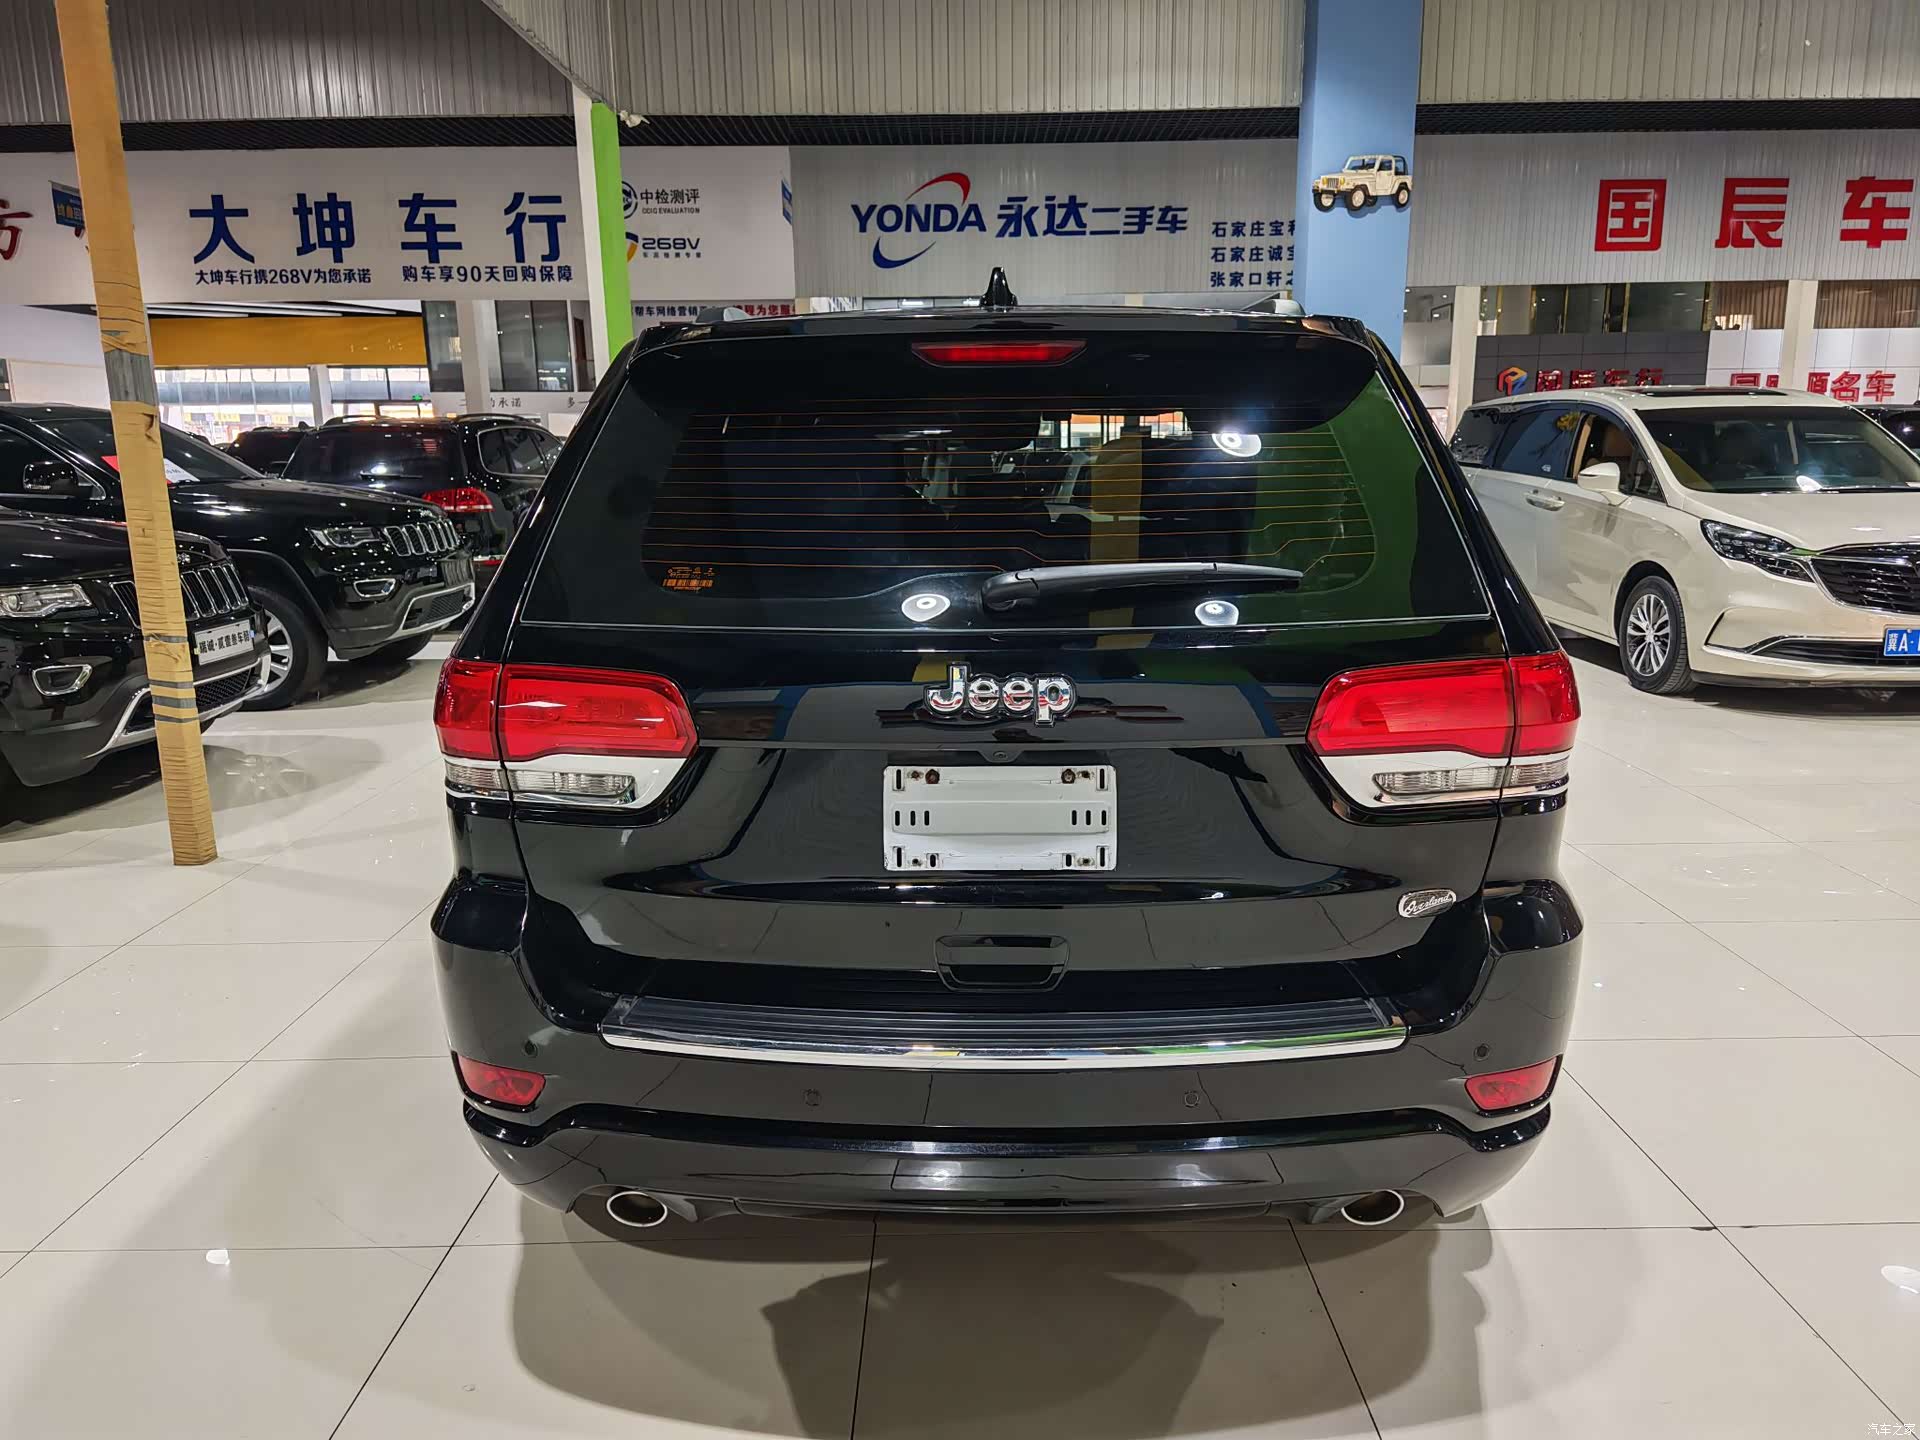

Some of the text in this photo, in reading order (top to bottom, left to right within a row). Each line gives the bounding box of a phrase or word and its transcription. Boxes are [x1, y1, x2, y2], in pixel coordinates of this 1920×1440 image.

[640, 188, 700, 205] 中检测评
[851, 195, 1189, 238] YONDA 永达二手车
[1594, 176, 1914, 252] 国辰车
[189, 192, 567, 264] 大坤车行
[642, 237, 700, 250] 268V
[195, 265, 573, 285] 大坤车行携268V为您承诺 购车享90天回购保障
[925, 662, 1078, 727] Jeep
